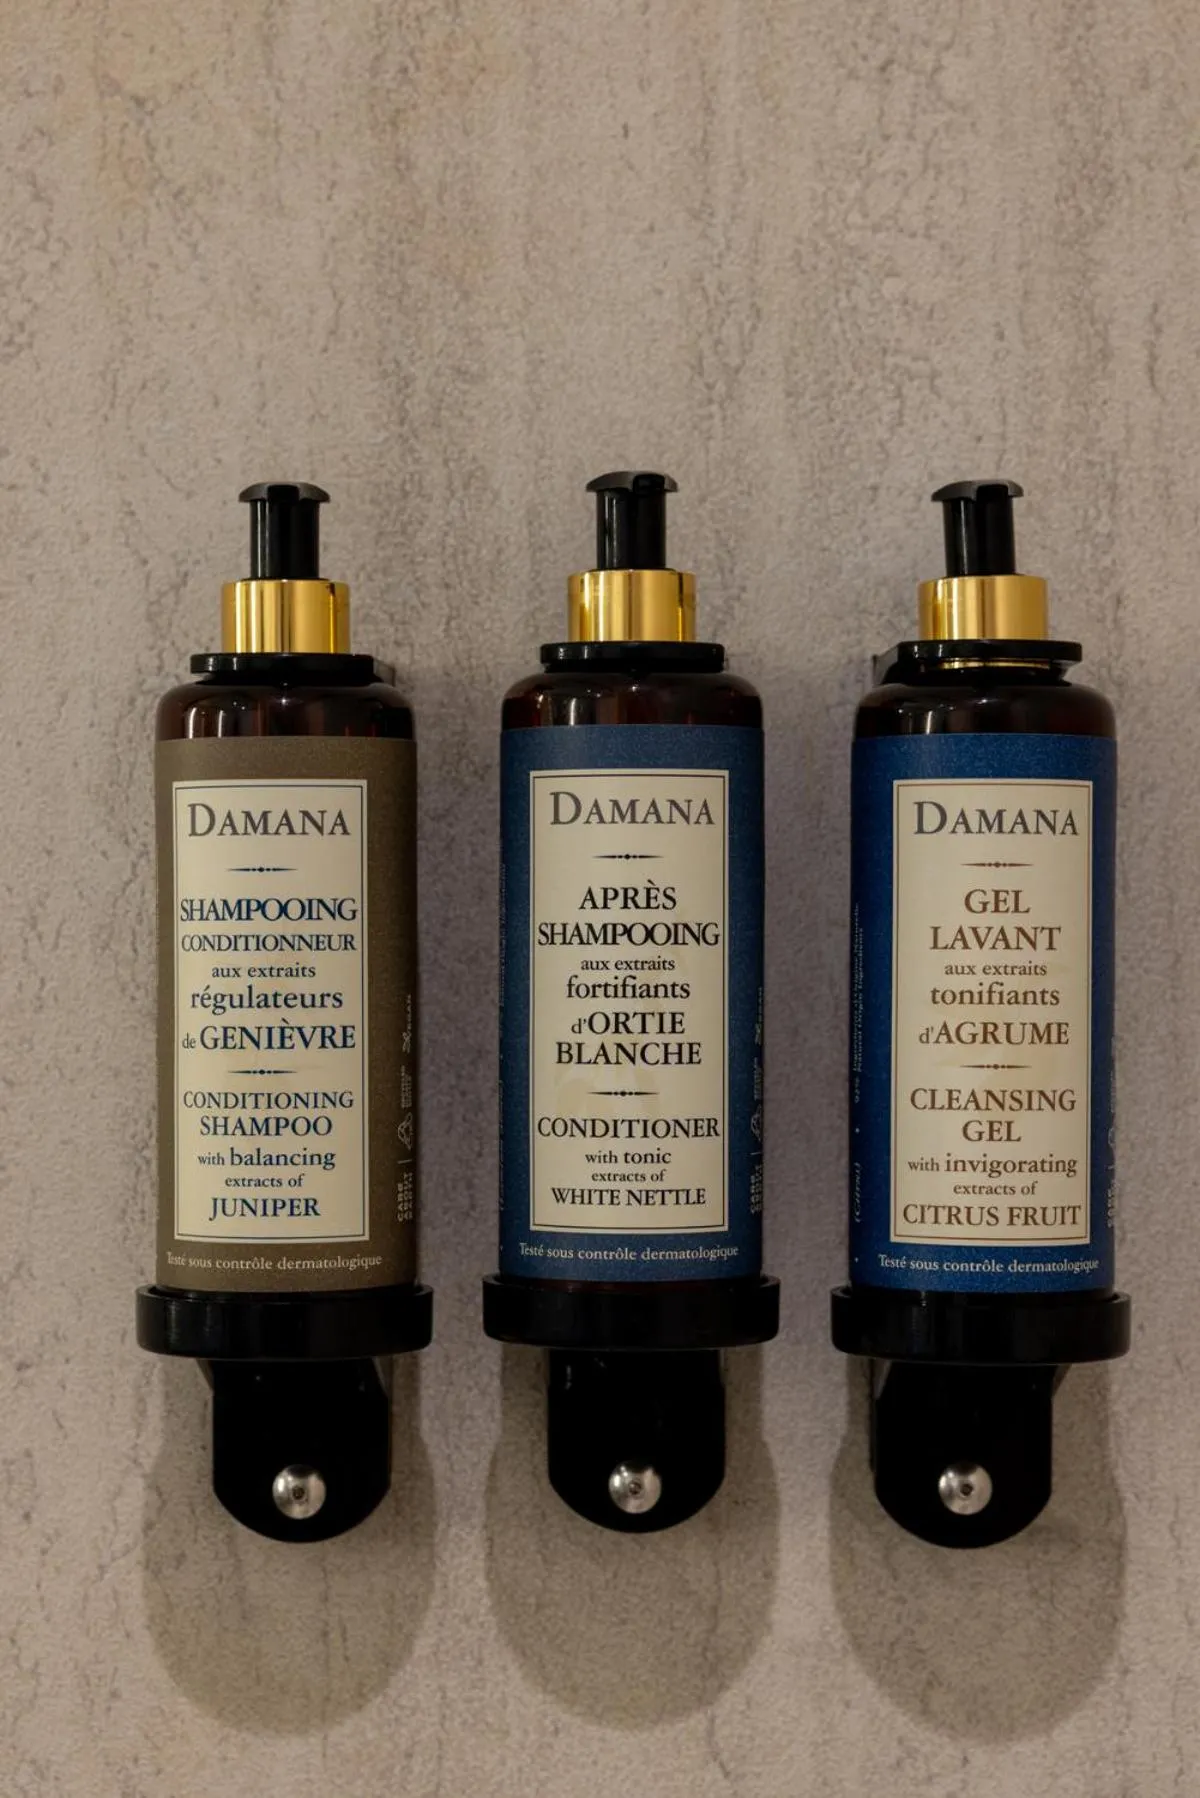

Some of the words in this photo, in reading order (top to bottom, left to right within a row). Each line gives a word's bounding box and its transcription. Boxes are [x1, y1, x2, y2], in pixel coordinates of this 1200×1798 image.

[578, 880, 677, 910] APRÈS
[964, 889, 1031, 913] GEL
[180, 898, 359, 921] SHAMPOOING
[181, 934, 357, 951] CONDITIONNEUR
[537, 923, 721, 946] SHAMPOOING
[930, 926, 1062, 951] LAVANT
[211, 967, 242, 978] aux
[247, 962, 317, 977] extraits
[580, 959, 611, 971] aux
[614, 955, 676, 970] extraits
[944, 964, 977, 976] aux
[982, 961, 1048, 976] extraits
[566, 975, 691, 999] fortifiants
[930, 982, 1060, 1005] tonifiants
[191, 985, 344, 1015] régulateurs
[181, 1031, 197, 1050] de
[200, 1018, 356, 1050] GENIÈVRE
[570, 1012, 686, 1034] d'ORTIE
[918, 1022, 1070, 1045] d'AGRUME
[556, 1042, 702, 1065] BLANCHE
[183, 1091, 355, 1109] CONDITIONING
[910, 1088, 1077, 1111] CLEANSING
[200, 1116, 333, 1136] SHAMPOO
[537, 1117, 721, 1138] CONDITIONER
[962, 1120, 1022, 1142] GEL
[197, 1152, 226, 1165] with
[230, 1147, 337, 1170] balancing
[584, 1151, 619, 1163] with
[623, 1148, 672, 1164] tonic
[907, 1157, 940, 1171] with
[945, 1153, 1078, 1178] invigorating
[224, 1178, 283, 1187] extracts
[287, 1172, 306, 1188] of
[591, 1173, 647, 1182] extracts
[650, 1168, 667, 1182] of
[551, 1188, 621, 1205] WHITE
[626, 1188, 706, 1205] NETTLE
[953, 1185, 1017, 1195] extracts
[1020, 1180, 1039, 1196] of
[208, 1198, 321, 1221] JUNIPER
[902, 1204, 1000, 1226] CITRUS
[1006, 1205, 1082, 1225] FRUIT
[188, 1257, 212, 1269] sous
[215, 1256, 273, 1270] contrôle
[275, 1253, 382, 1271] dermatologique
[519, 1242, 545, 1257] Testé
[546, 1248, 574, 1259] sous
[577, 1247, 637, 1261] contrôle
[640, 1244, 739, 1262] dermatologique
[878, 1253, 907, 1269] Testé
[909, 1260, 940, 1271] sous
[942, 1259, 1004, 1273] contrôle
[1007, 1258, 1099, 1274] dermatologique
